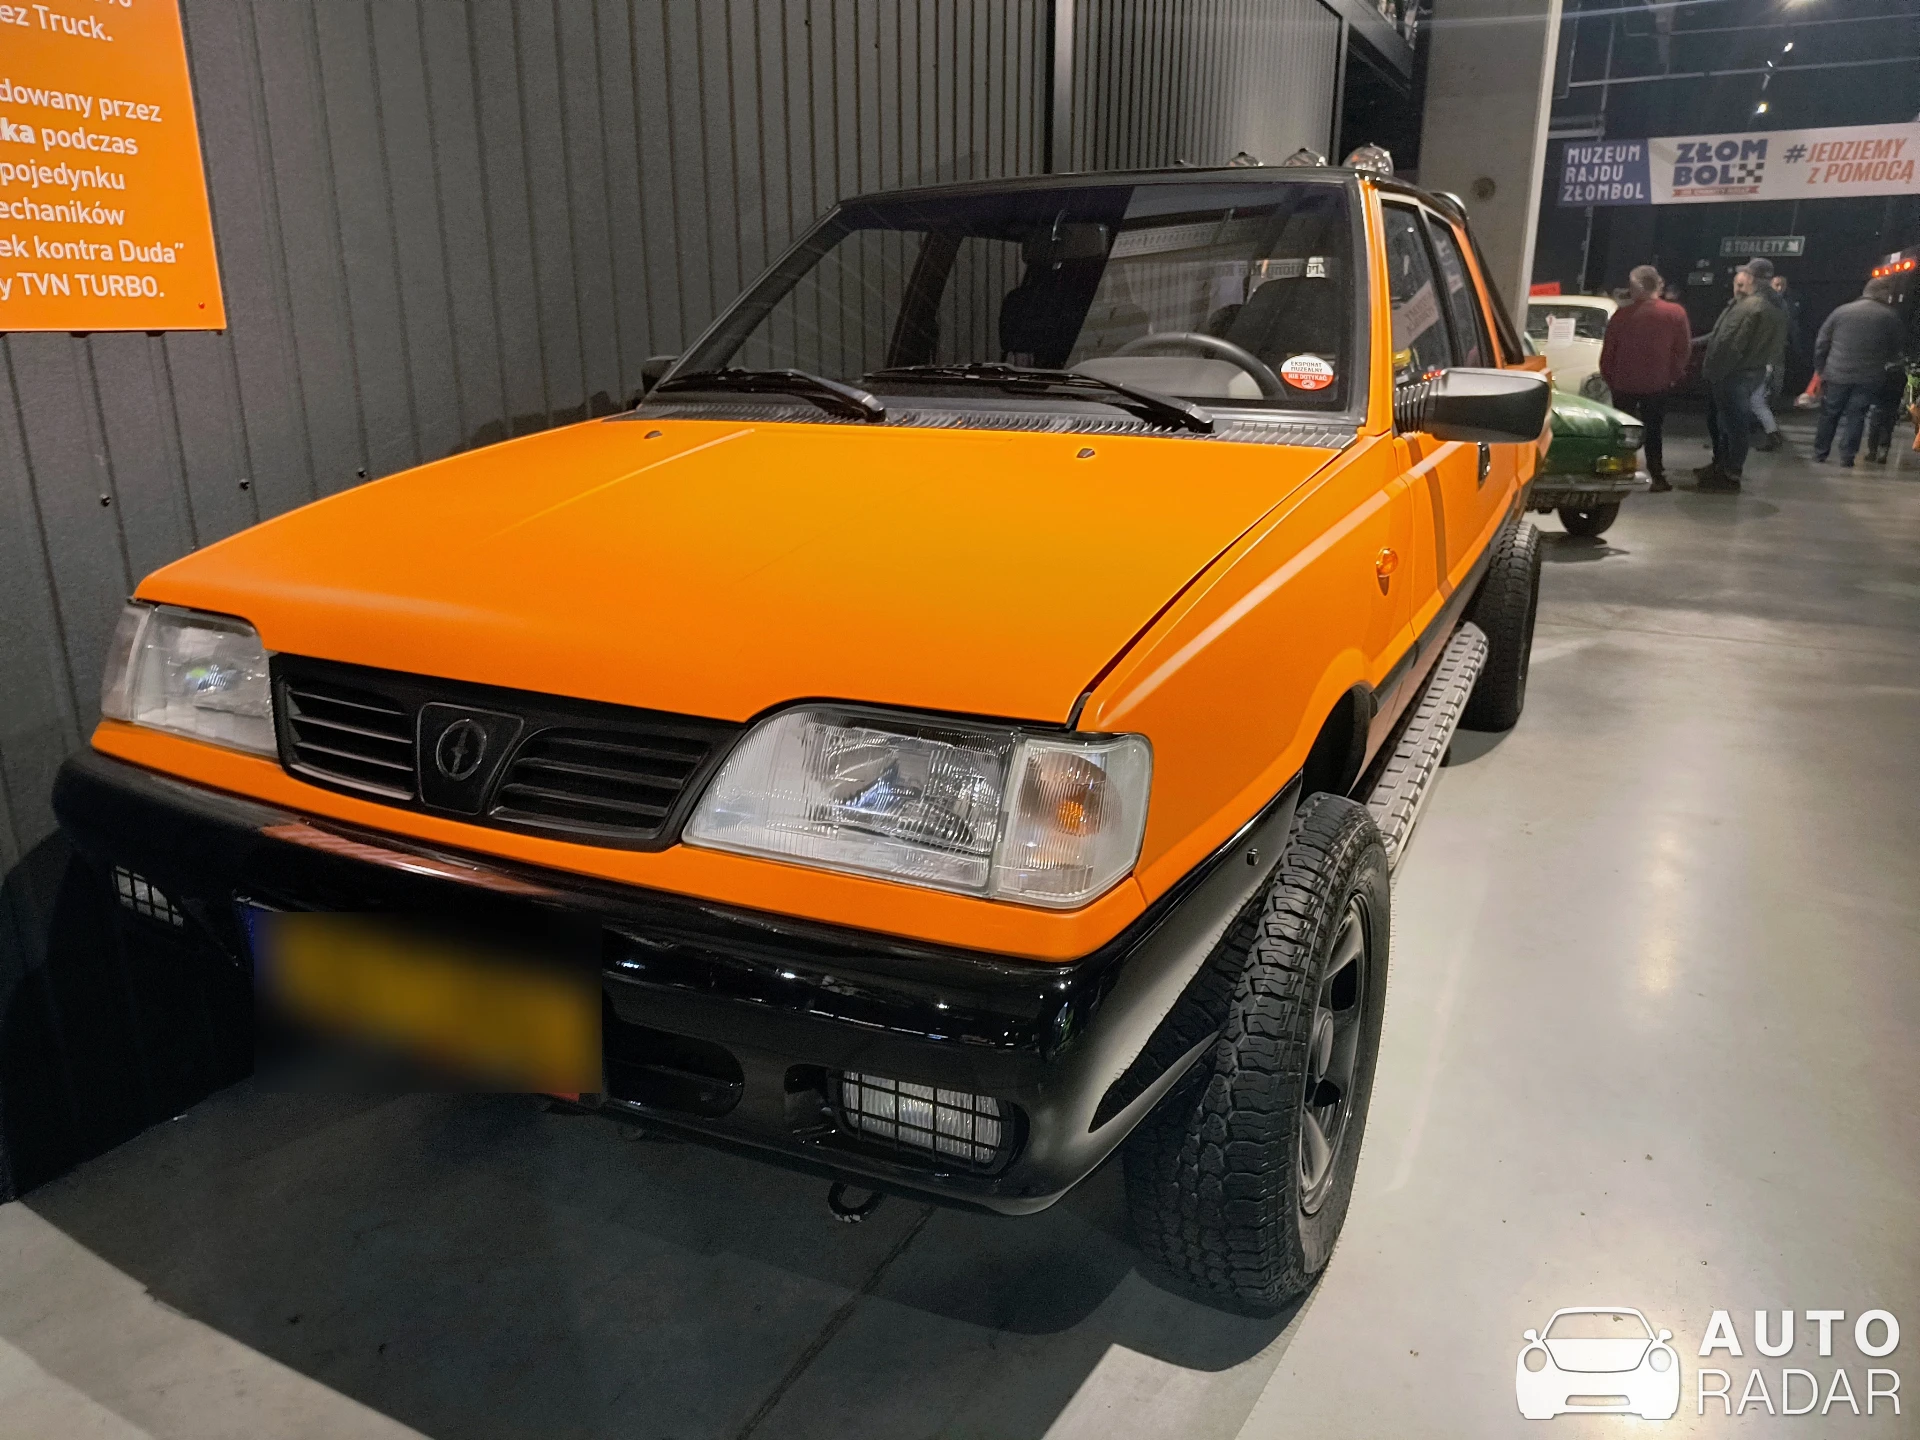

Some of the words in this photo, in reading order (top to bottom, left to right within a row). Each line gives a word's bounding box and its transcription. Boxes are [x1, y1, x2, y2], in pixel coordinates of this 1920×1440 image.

[32, 4, 113, 41] Truck.
[99, 97, 162, 122] przez
[41, 127, 138, 155] podczas
[1675, 138, 1768, 164] ZŁOM
[1784, 138, 1907, 164] #JEDZIEMY
[1567, 145, 1640, 165] MUZEUM
[0, 159, 125, 190] pojedynku
[1565, 165, 1623, 183] RAJDU
[1672, 164, 1735, 187] BOL
[1823, 160, 1915, 184] POMOCĄ
[1563, 183, 1644, 201] ZŁOMBOL
[33, 235, 113, 262] kontra
[1735, 240, 1784, 253] TOALETY
[16, 272, 70, 296] TVN
[74, 274, 164, 298] TURBO.
